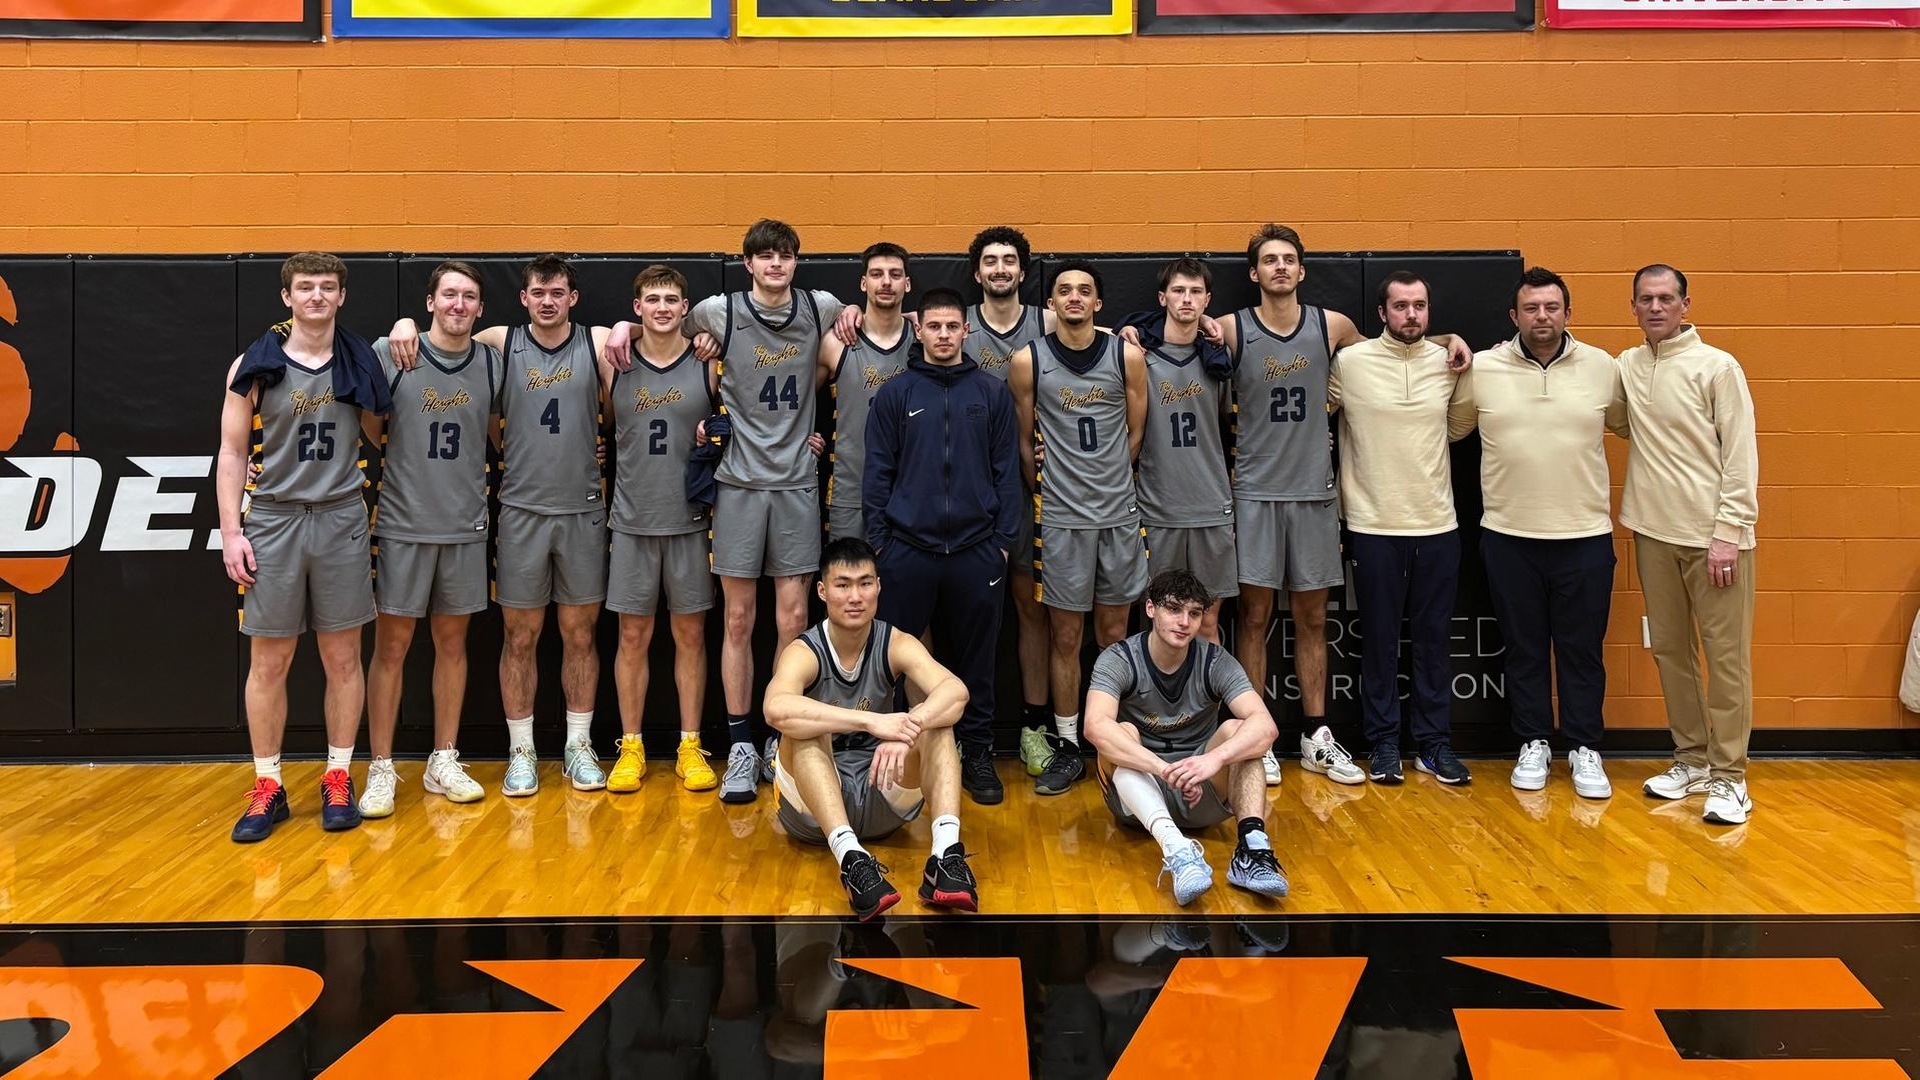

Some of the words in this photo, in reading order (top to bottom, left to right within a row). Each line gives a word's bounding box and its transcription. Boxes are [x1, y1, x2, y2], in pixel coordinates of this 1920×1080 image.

[753, 345, 767, 355] The
[754, 342, 799, 370] Heights
[525, 367, 540, 378] The
[525, 366, 573, 391] Heights
[1264, 353, 1309, 381] Heights
[421, 387, 472, 413] Heights
[422, 386, 437, 399] The
[634, 386, 649, 399] The
[634, 386, 683, 412] Heights
[759, 375, 799, 411] 44
[1061, 384, 1106, 411] Heights
[1160, 379, 1203, 406] Heights
[1270, 386, 1307, 423] 23
[540, 398, 560, 434] 4
[1170, 412, 1197, 448] 12
[298, 422, 336, 461] 25
[427, 421, 461, 460] 13
[649, 419, 668, 455] 2
[1077, 416, 1098, 452] 0
